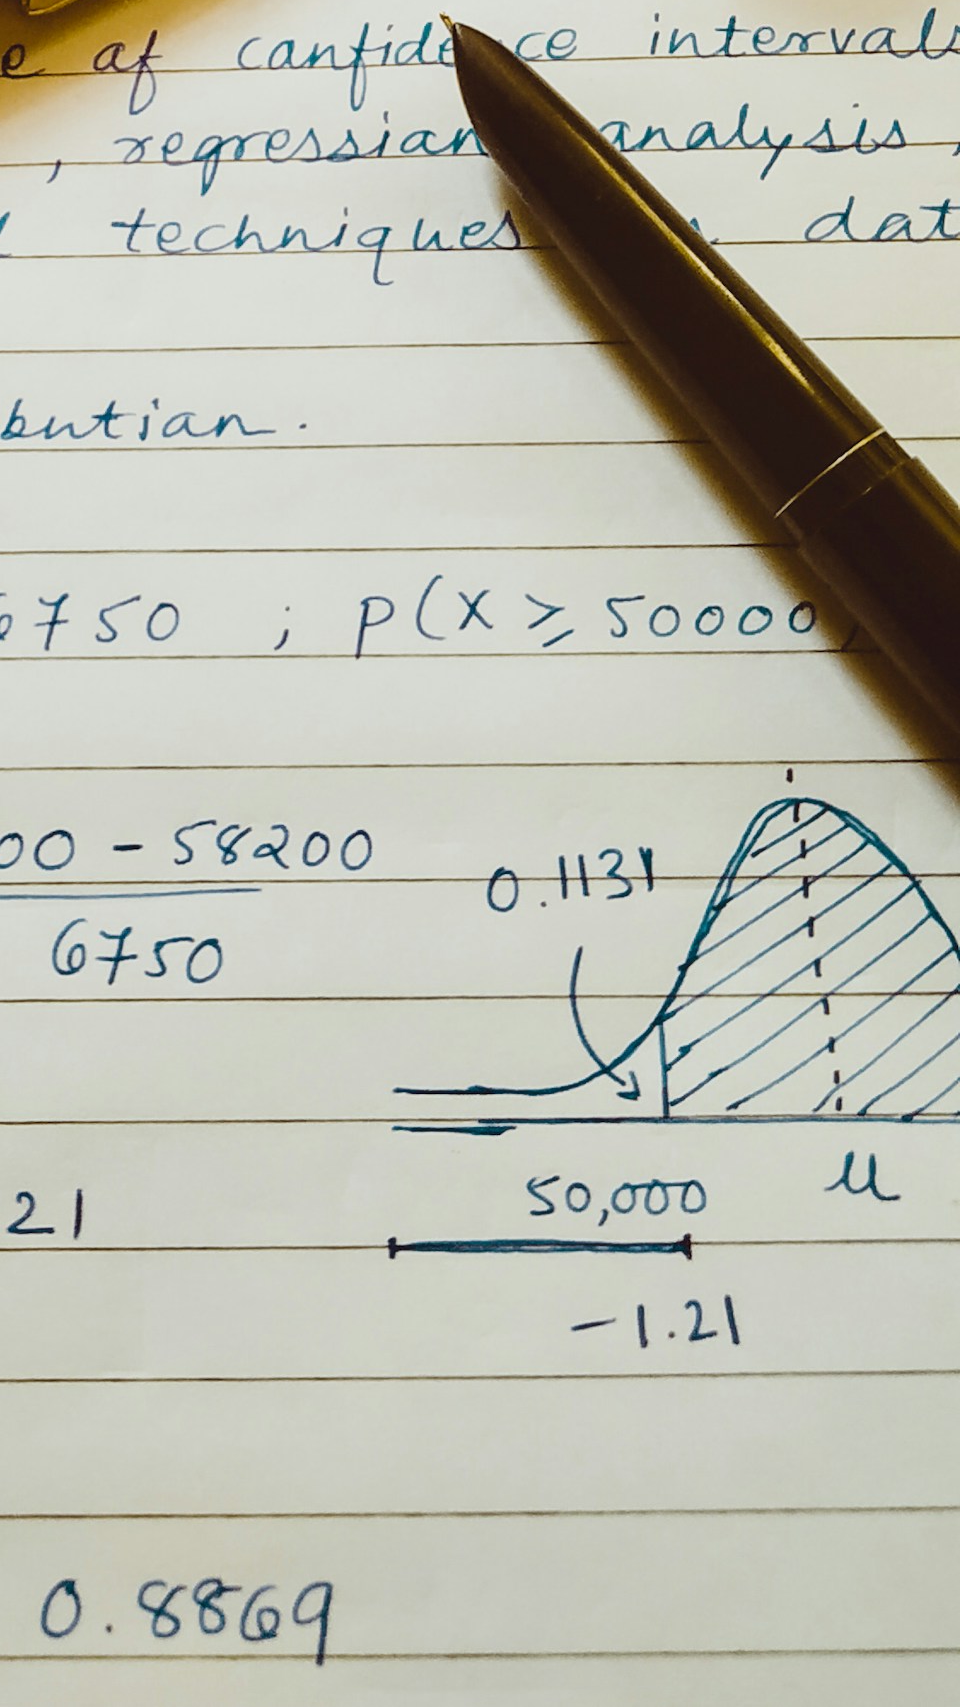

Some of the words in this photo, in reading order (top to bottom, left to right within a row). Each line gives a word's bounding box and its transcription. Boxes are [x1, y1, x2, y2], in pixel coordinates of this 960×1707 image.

[238, 20, 578, 112] confidece
[804, 195, 960, 245] dat
[171, 819, 375, 872] 58200
[486, 846, 656, 913] 0.1131
[51, 918, 224, 985] 6750
[526, 1175, 708, 1227] 50,000
[39, 1579, 338, 1669] 0.8869
